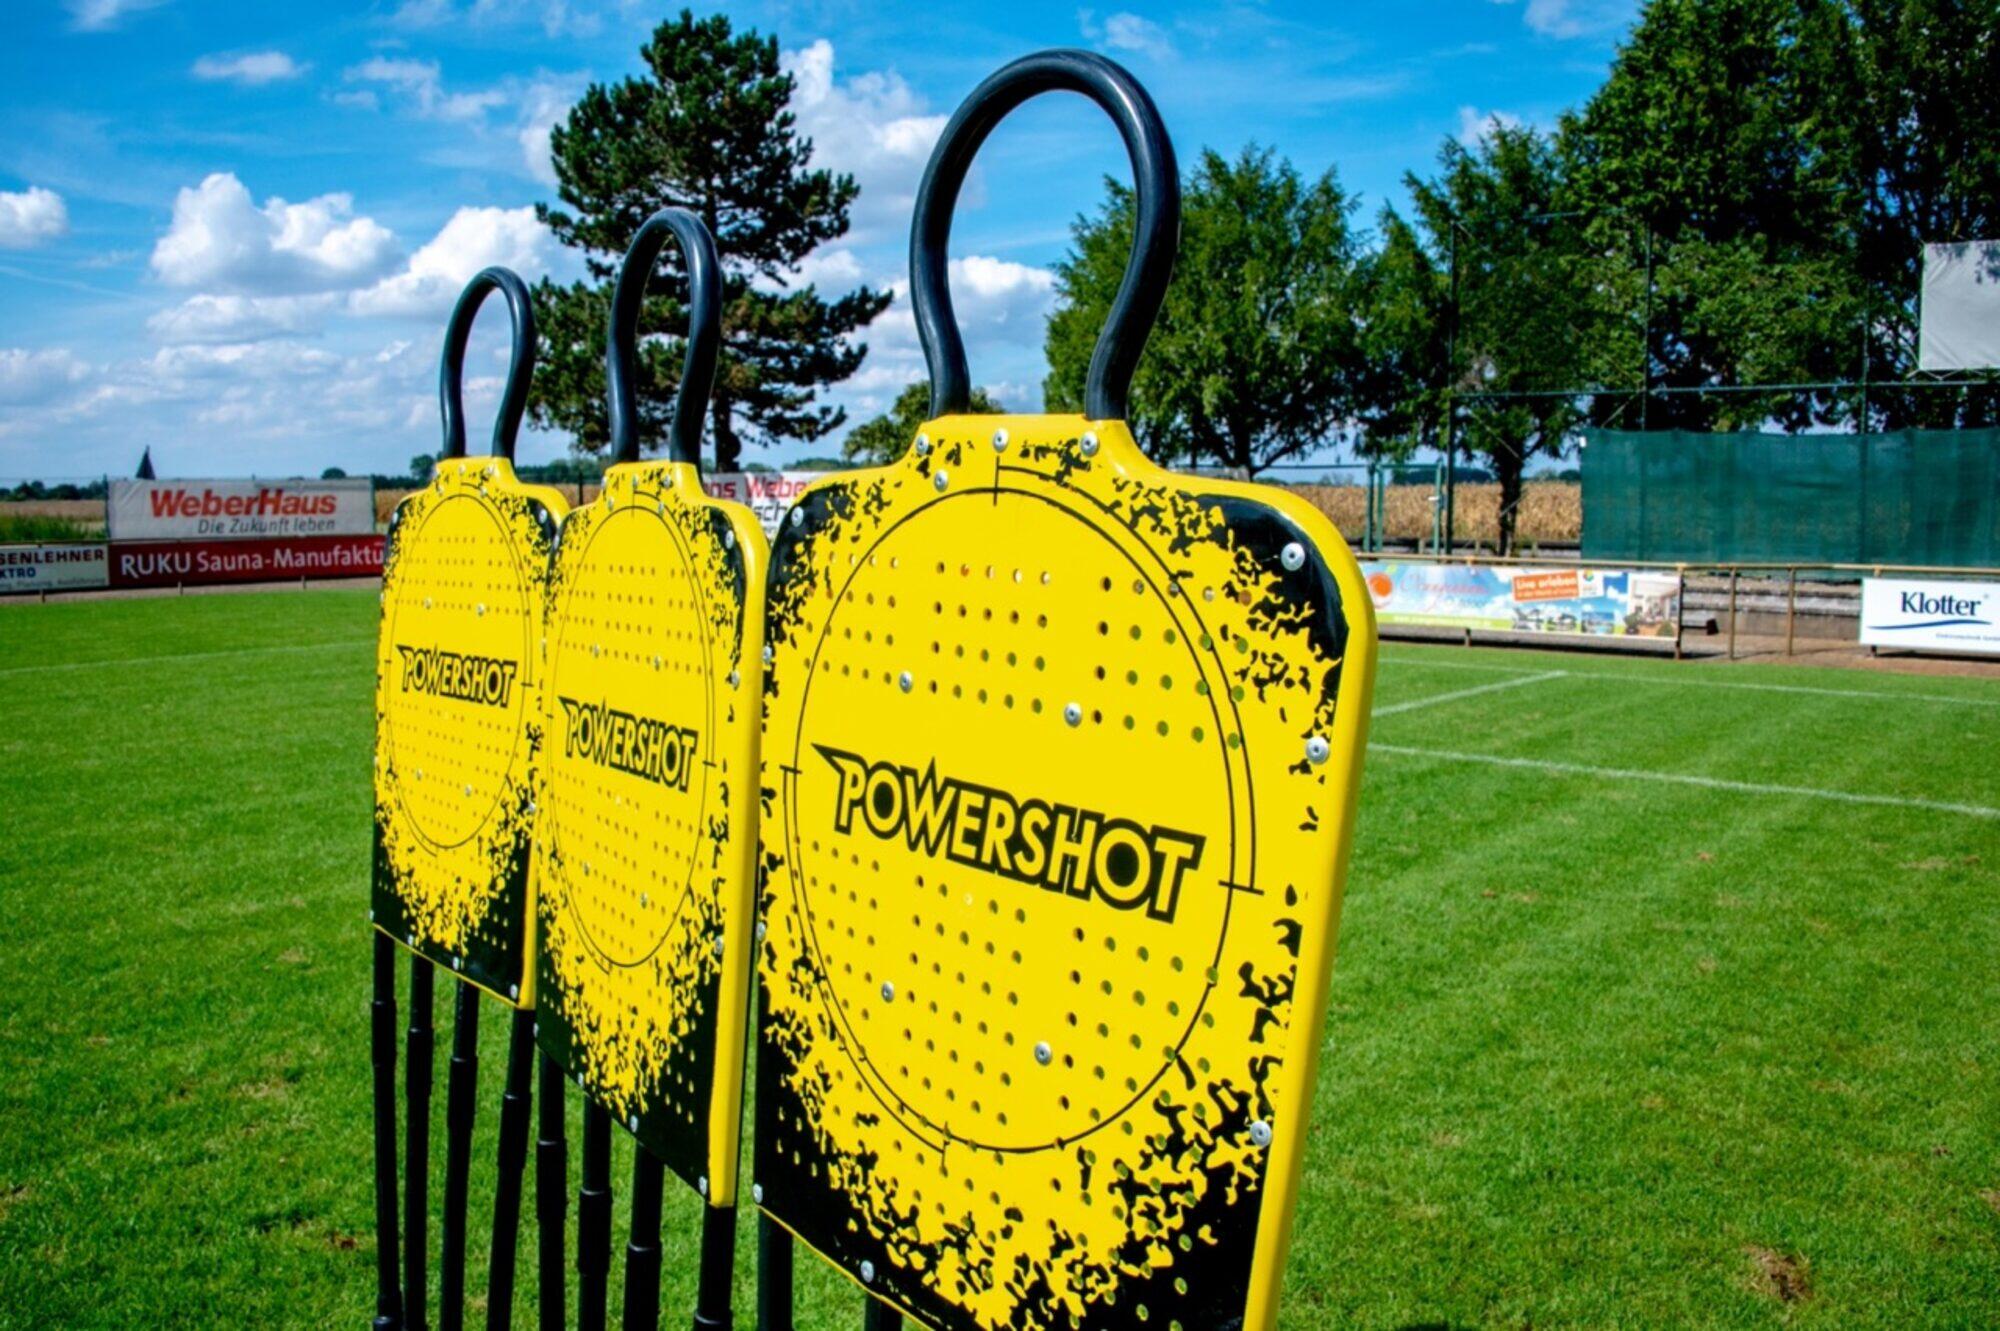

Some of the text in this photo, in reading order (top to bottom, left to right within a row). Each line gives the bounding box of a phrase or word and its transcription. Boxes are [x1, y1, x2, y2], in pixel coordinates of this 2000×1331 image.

[150, 489, 337, 517] WeberHaus
[198, 517, 336, 534] Die Zukunft leben
[121, 552, 191, 578] RUKU
[1900, 591, 1982, 616] Klotter
[396, 643, 518, 708] POWERSHOT
[558, 696, 699, 793] POWERSHOT
[811, 743, 1207, 924] POWERSHOT
